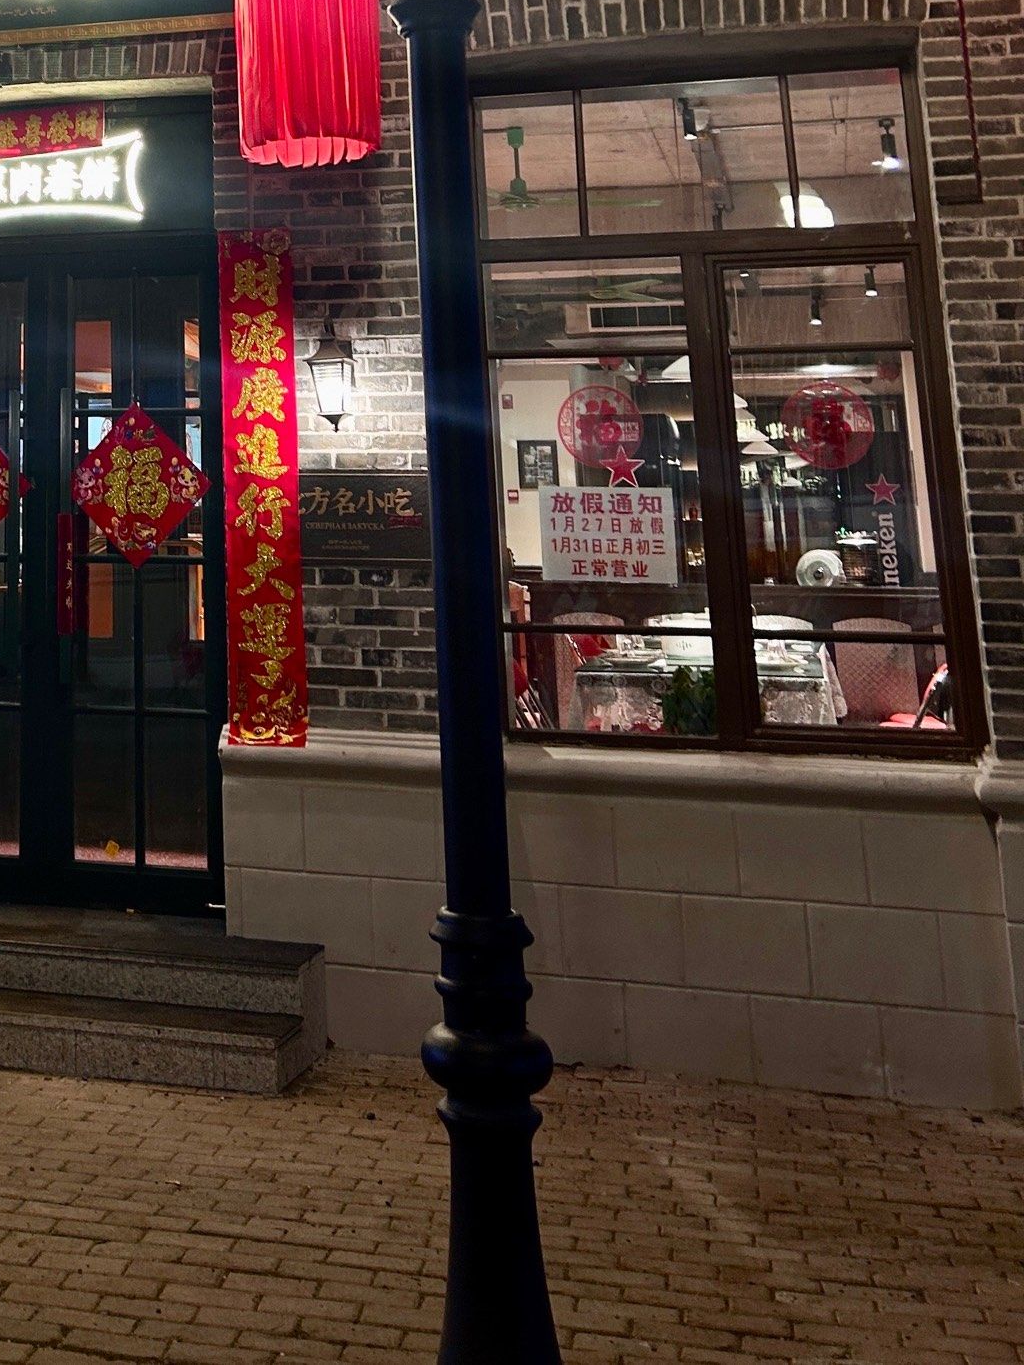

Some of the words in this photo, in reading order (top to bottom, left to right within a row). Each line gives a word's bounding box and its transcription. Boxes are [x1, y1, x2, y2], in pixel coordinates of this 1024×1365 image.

[104, 444, 170, 520] 福
[298, 486, 416, 517] 方名小吃
[550, 491, 663, 515] 放假通知
[550, 516, 665, 535] 1月27日放假
[551, 536, 666, 556] 1月31日正月初三
[878, 512, 900, 587] neken
[571, 558, 649, 579] 正常营业
